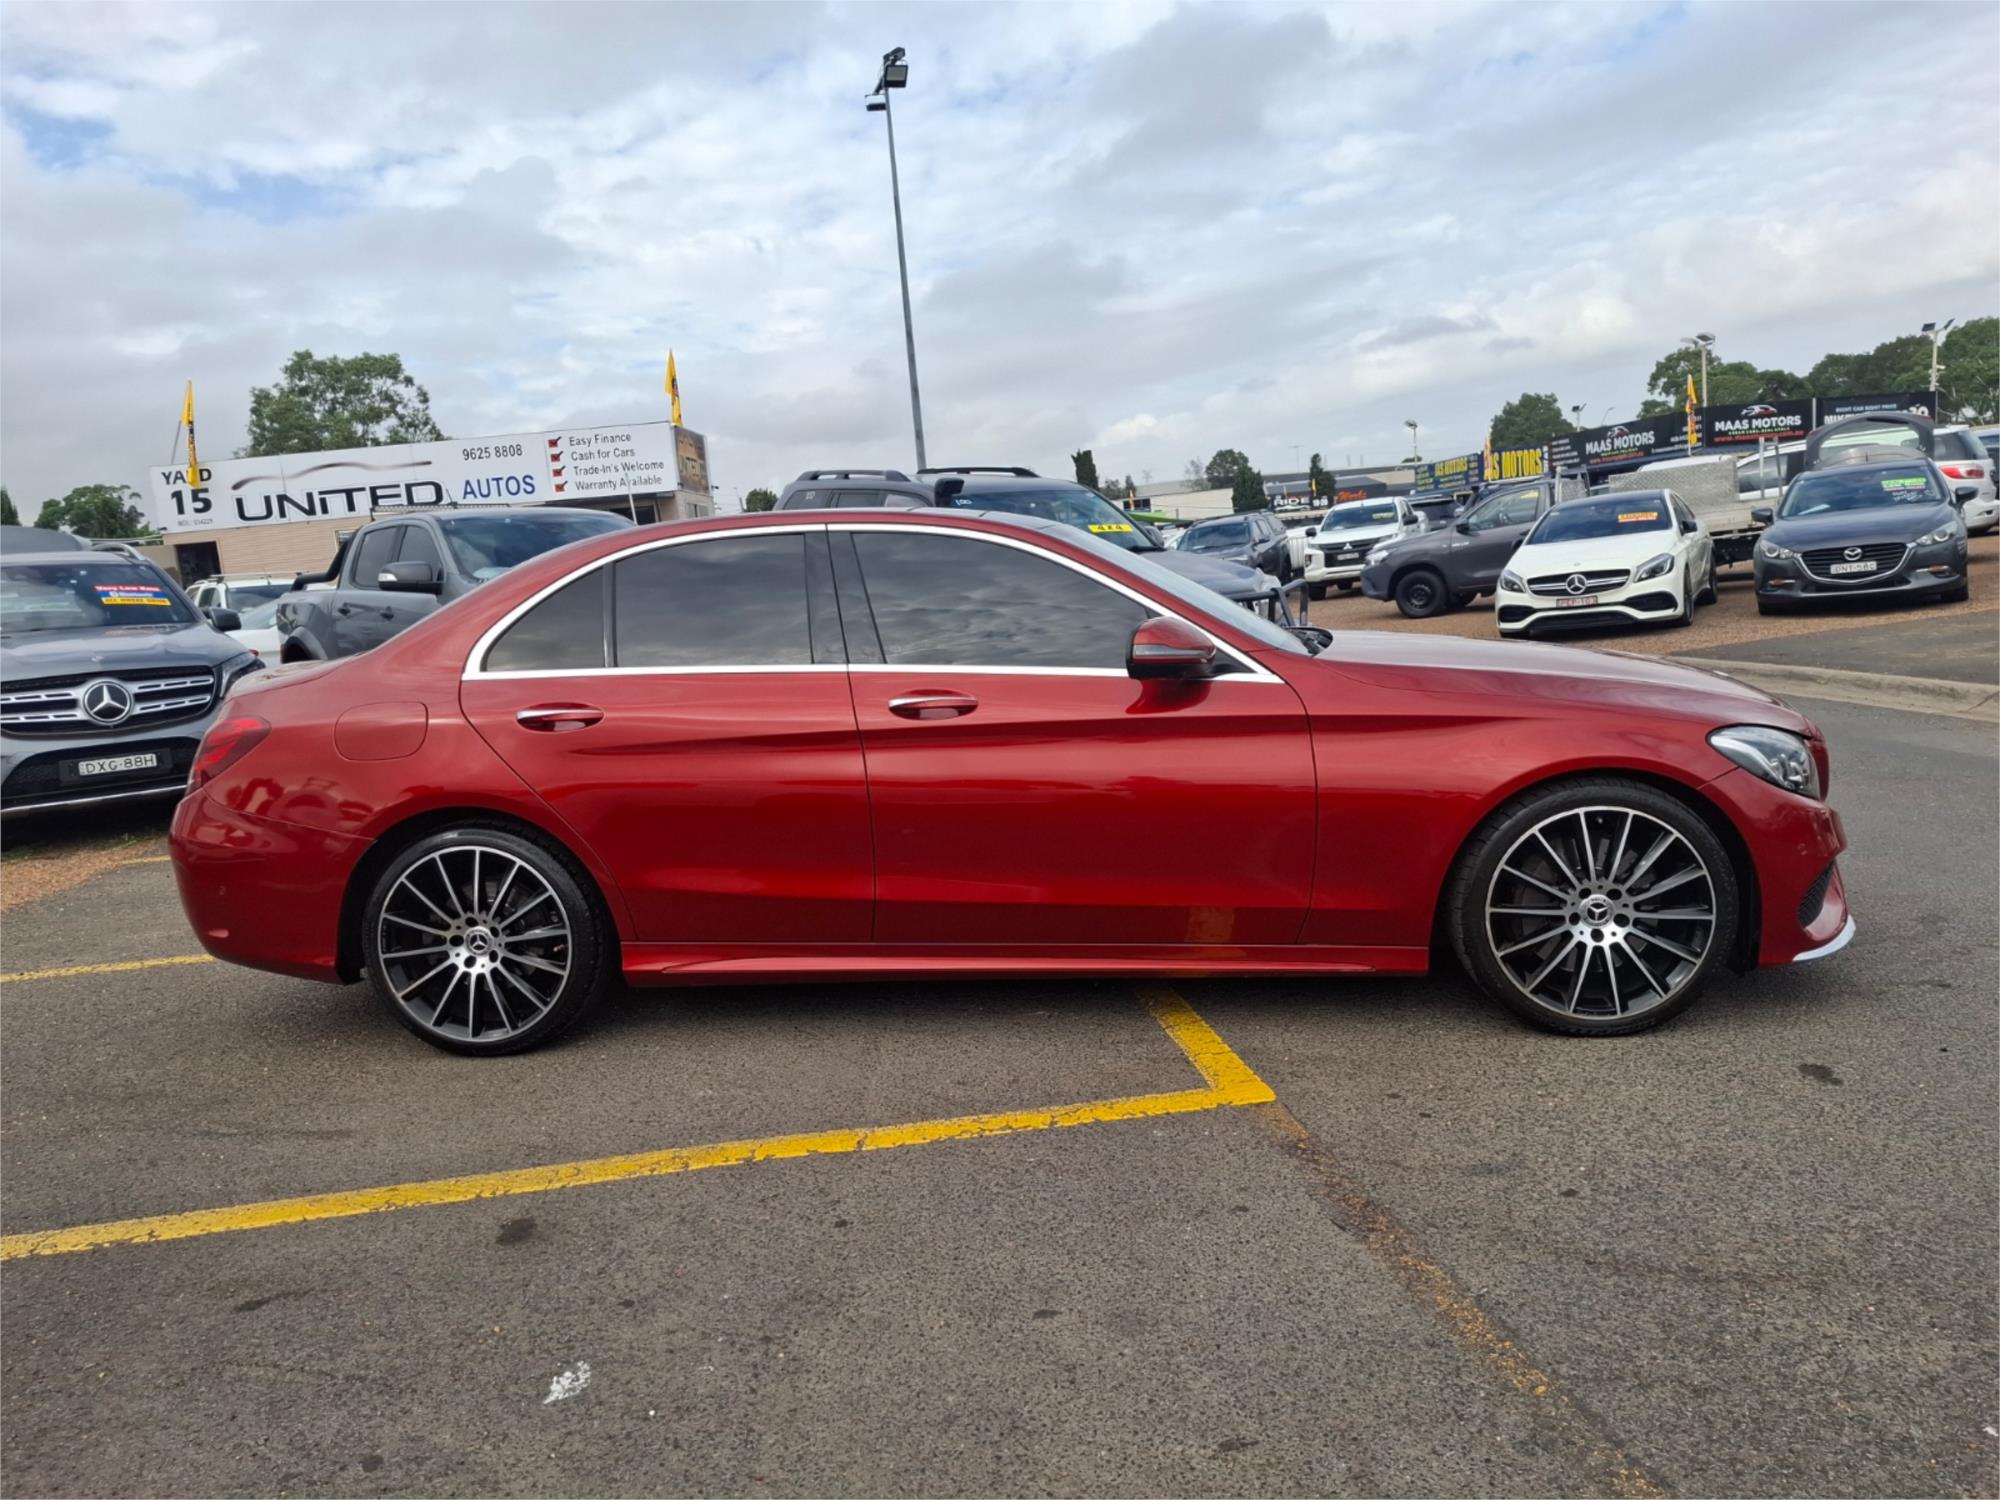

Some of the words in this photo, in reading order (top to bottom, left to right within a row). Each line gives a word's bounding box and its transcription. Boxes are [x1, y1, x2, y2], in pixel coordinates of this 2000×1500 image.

[1714, 420, 1750, 432] MAAS
[1752, 415, 1802, 428] MOTORS
[569, 435, 592, 447] Easy
[594, 433, 632, 444] Finance
[1585, 439, 1612, 455] MAAS
[1613, 431, 1656, 449] MOTORS
[462, 447, 491, 461] 9625
[494, 444, 523, 458] 8808
[570, 450, 595, 461] Cash
[597, 449, 610, 459] for
[613, 447, 636, 458] Cars
[573, 463, 620, 476] Trade-In's
[621, 460, 664, 472] Welcome
[1502, 448, 1543, 479] MOTORS
[161, 468, 212, 485] YAD
[575, 479, 617, 491] Warranty
[171, 487, 212, 515] 15
[235, 481, 443, 521] UNITED
[462, 474, 536, 500] AUTOS
